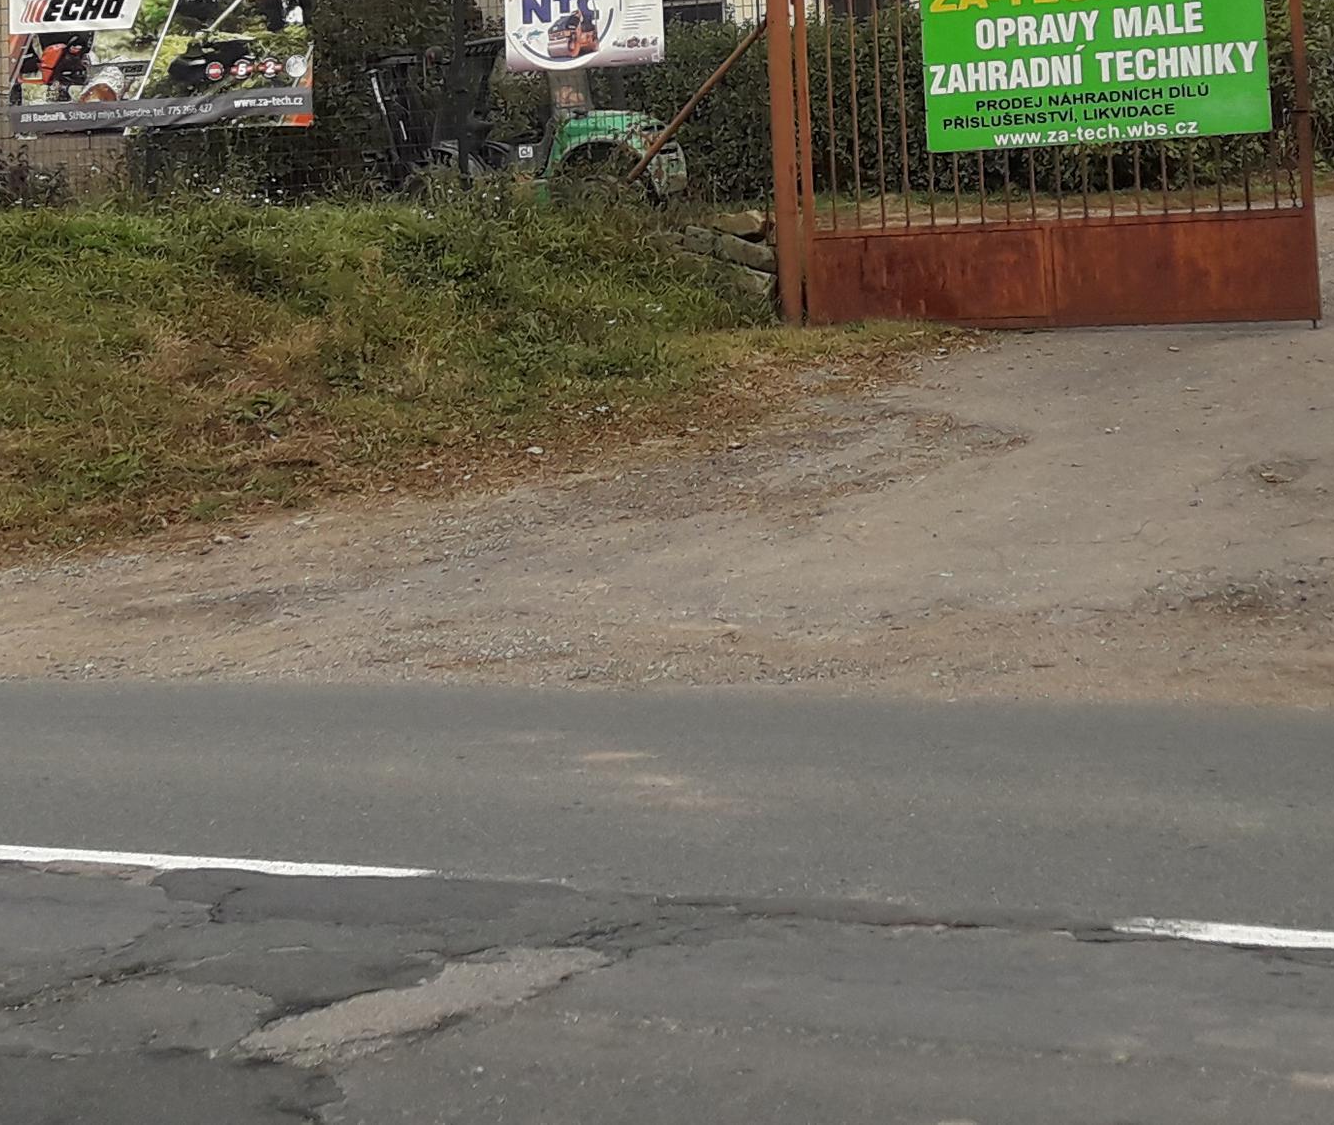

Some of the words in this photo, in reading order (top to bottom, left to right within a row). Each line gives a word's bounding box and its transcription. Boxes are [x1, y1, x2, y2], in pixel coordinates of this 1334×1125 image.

[975, 9, 1100, 50] OPRAVY
[929, 45, 1083, 95] ZAHRADNÍ
[1095, 40, 1259, 84] TECHNIKY
[233, 96, 304, 108] www.za-tech.cz
[975, 97, 1044, 112] PRODEJ
[1048, 86, 1164, 107] NÁHRADNÍCH
[943, 108, 1078, 130] PŘÍSLUŠENSTVÍ,
[1083, 103, 1176, 121] LIKVIDACE
[994, 120, 1199, 146] www.za-tech.wbs.cz
